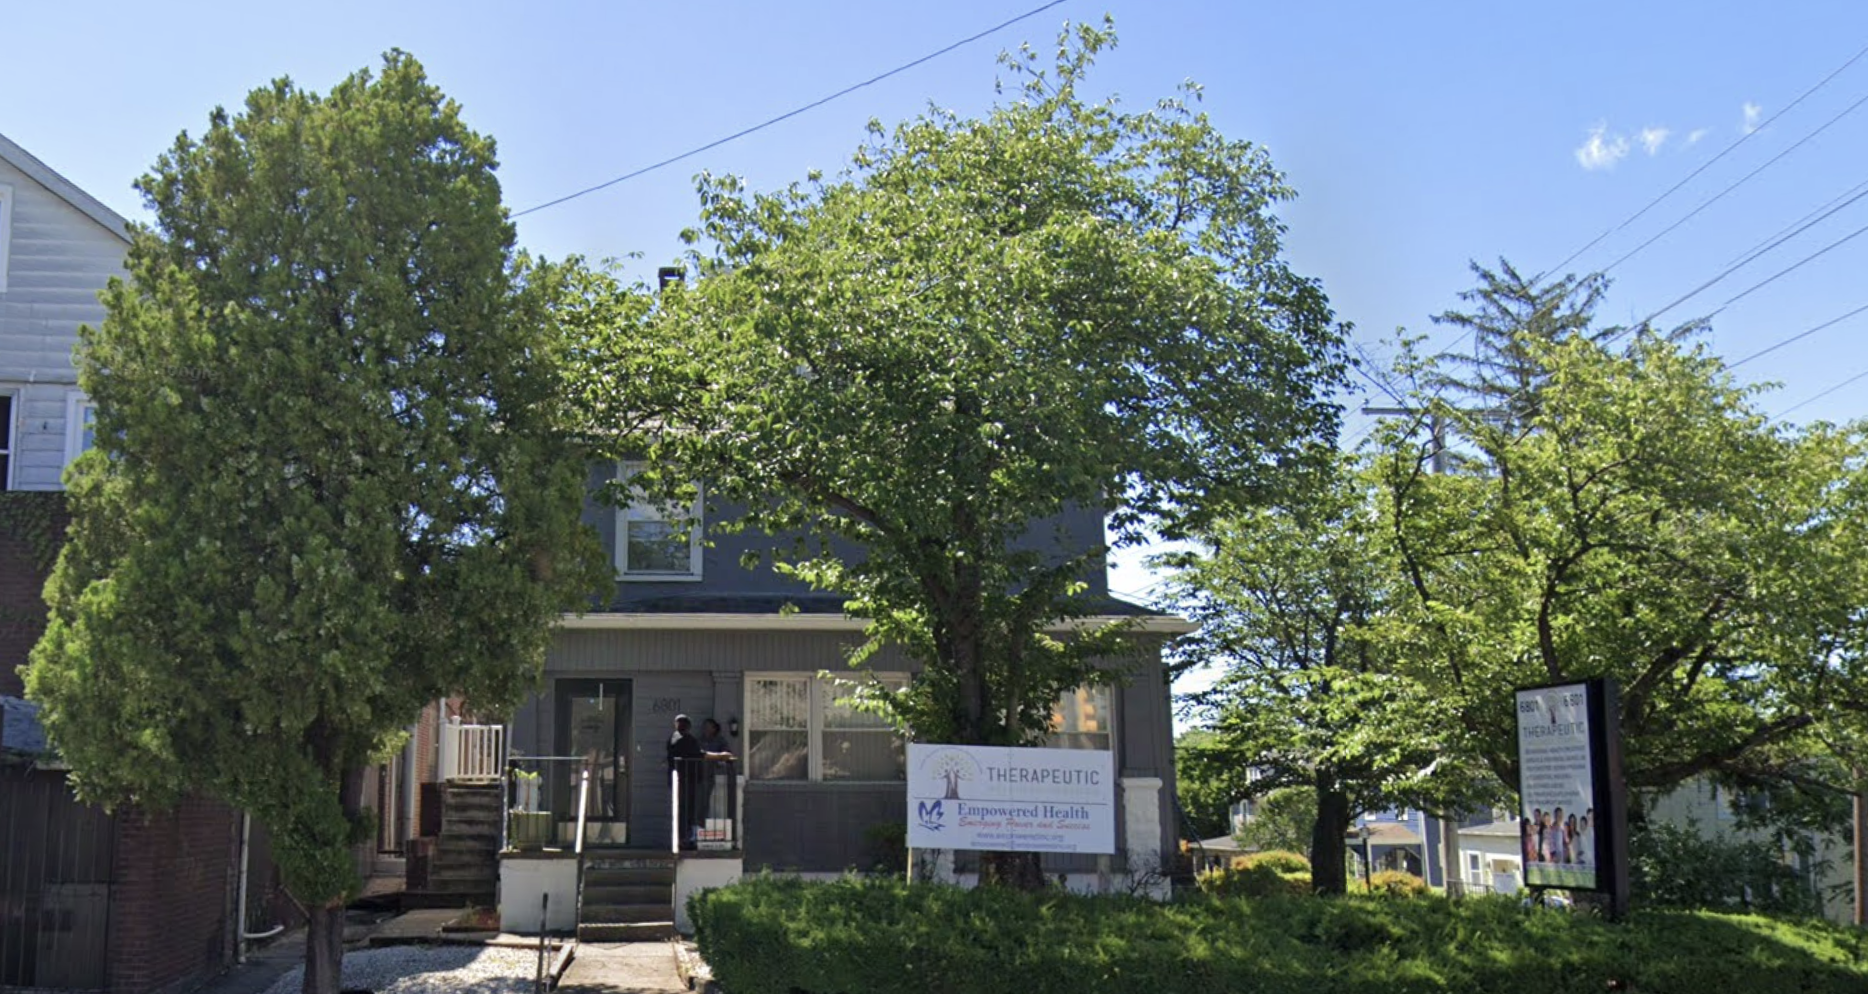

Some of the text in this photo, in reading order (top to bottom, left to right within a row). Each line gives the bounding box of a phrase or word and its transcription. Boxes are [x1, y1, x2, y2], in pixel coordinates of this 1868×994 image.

[652, 697, 681, 713] 6801
[1523, 721, 1585, 738] THERAPEUTIC
[987, 767, 1100, 785] THERAPEUTIC
[958, 802, 1089, 820] Empowered Health
